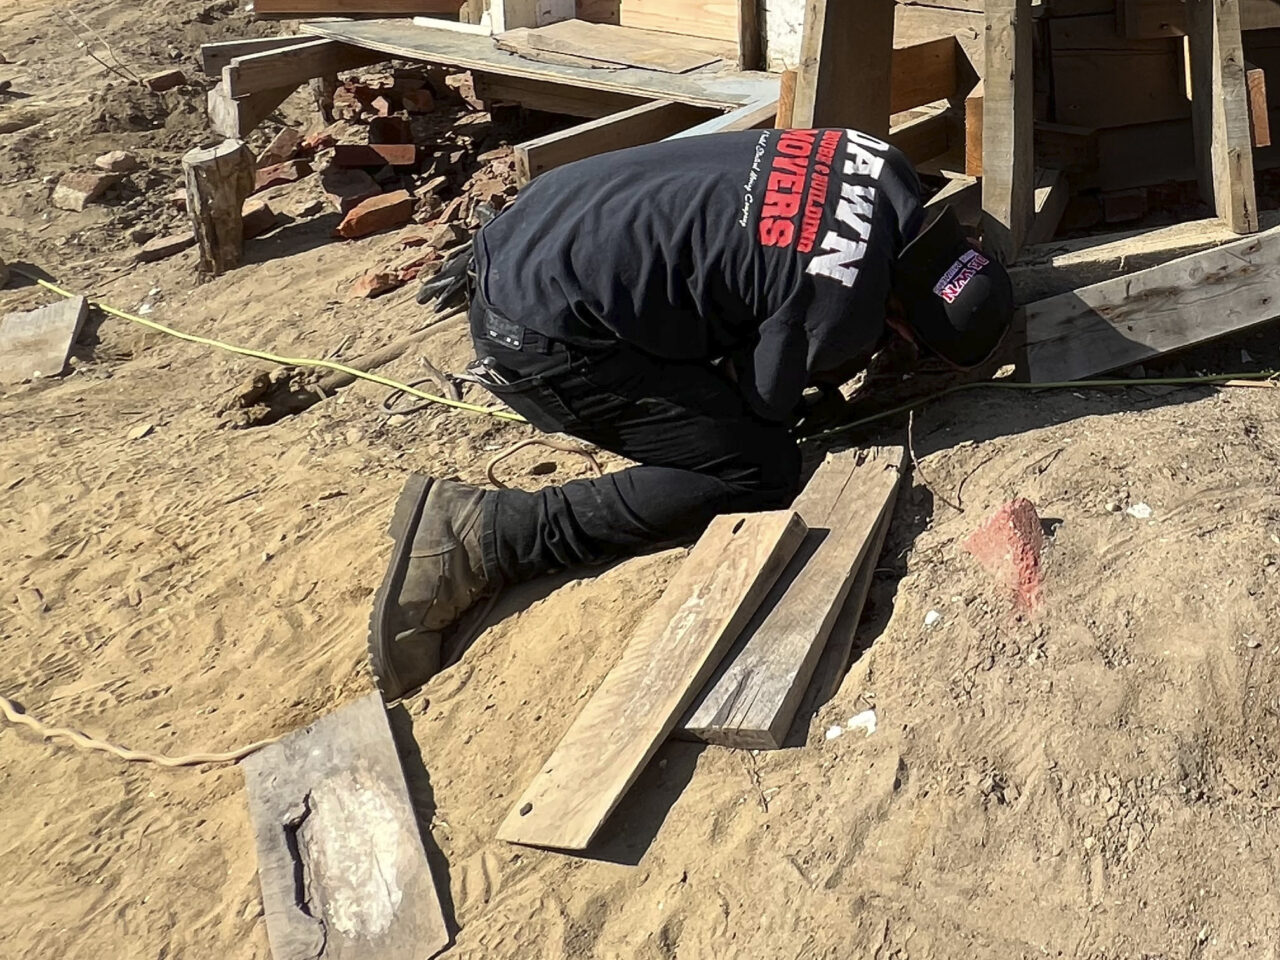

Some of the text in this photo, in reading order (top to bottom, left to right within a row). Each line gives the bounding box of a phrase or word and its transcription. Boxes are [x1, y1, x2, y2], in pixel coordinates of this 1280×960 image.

[758, 129, 820, 249] MOVERS
[796, 172, 829, 253] BUILDING
[806, 128, 890, 288] DAWN
